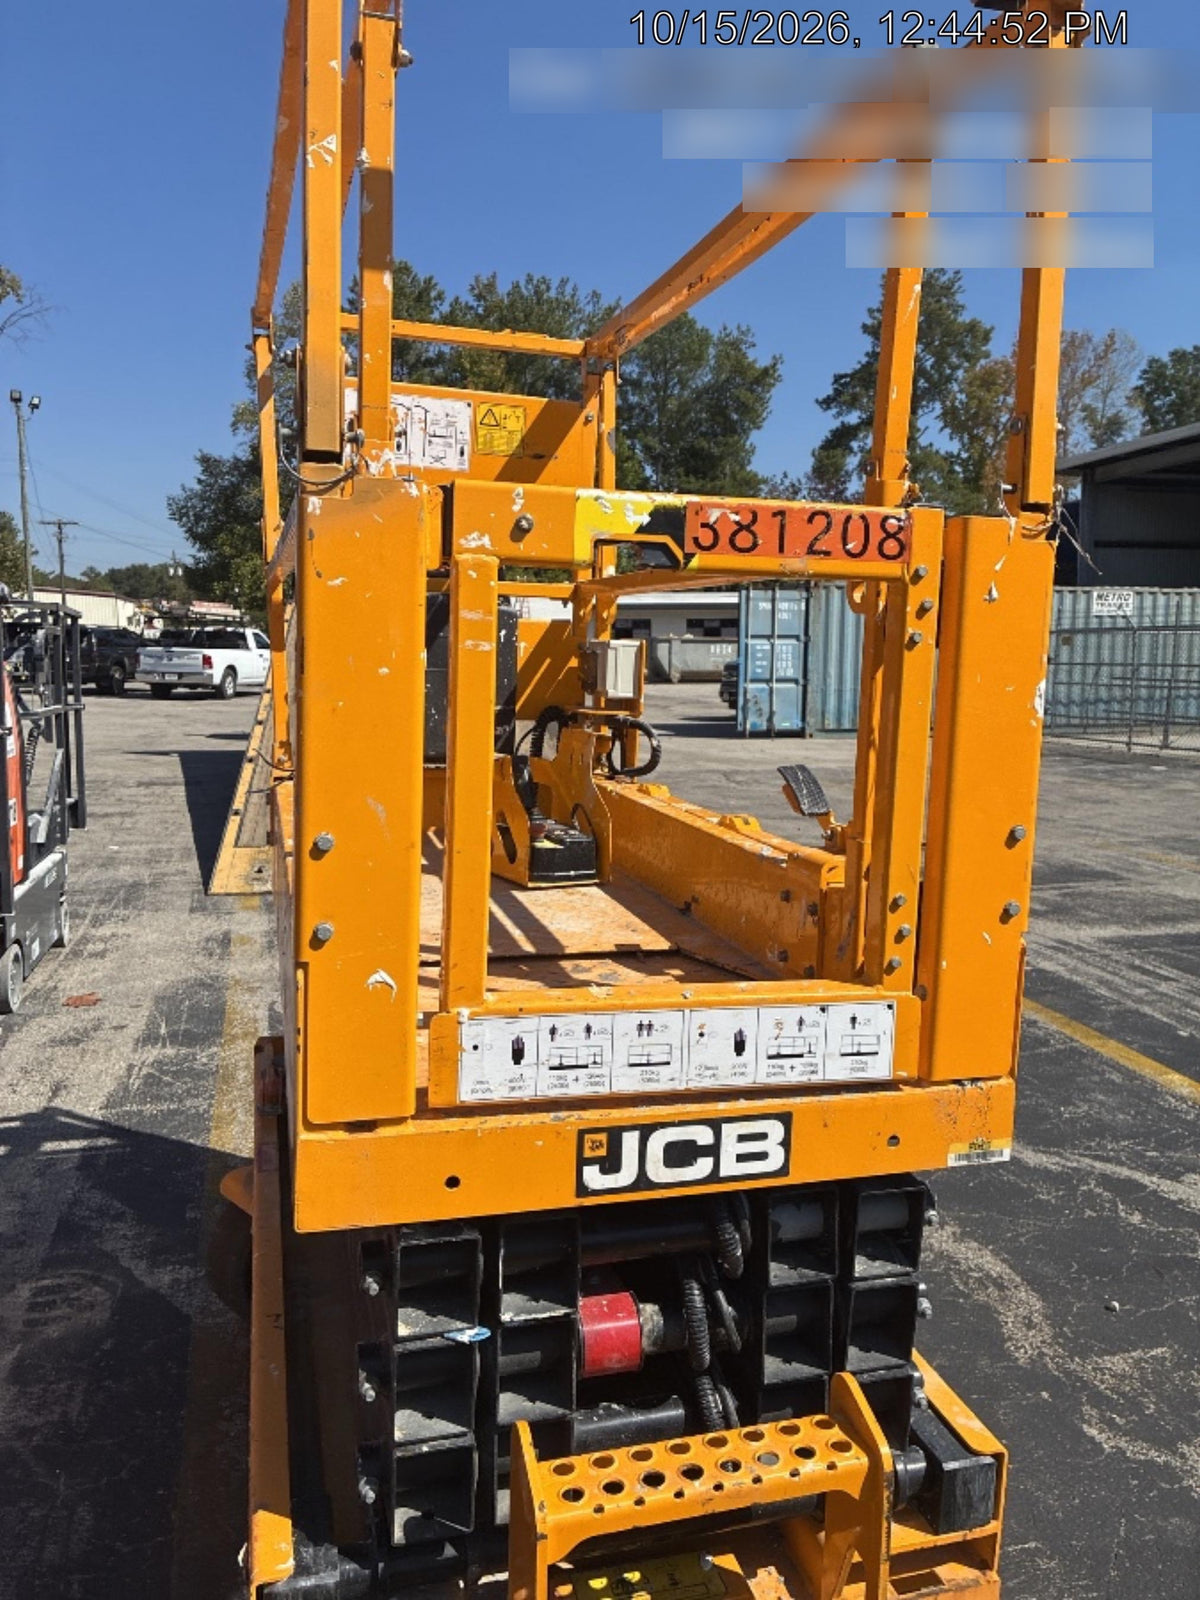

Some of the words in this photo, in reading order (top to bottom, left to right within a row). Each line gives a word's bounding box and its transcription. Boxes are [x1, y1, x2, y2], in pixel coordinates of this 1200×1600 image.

[692, 506, 906, 561] 381208
[1096, 592, 1132, 602] METRO
[582, 1119, 786, 1191] JCB
